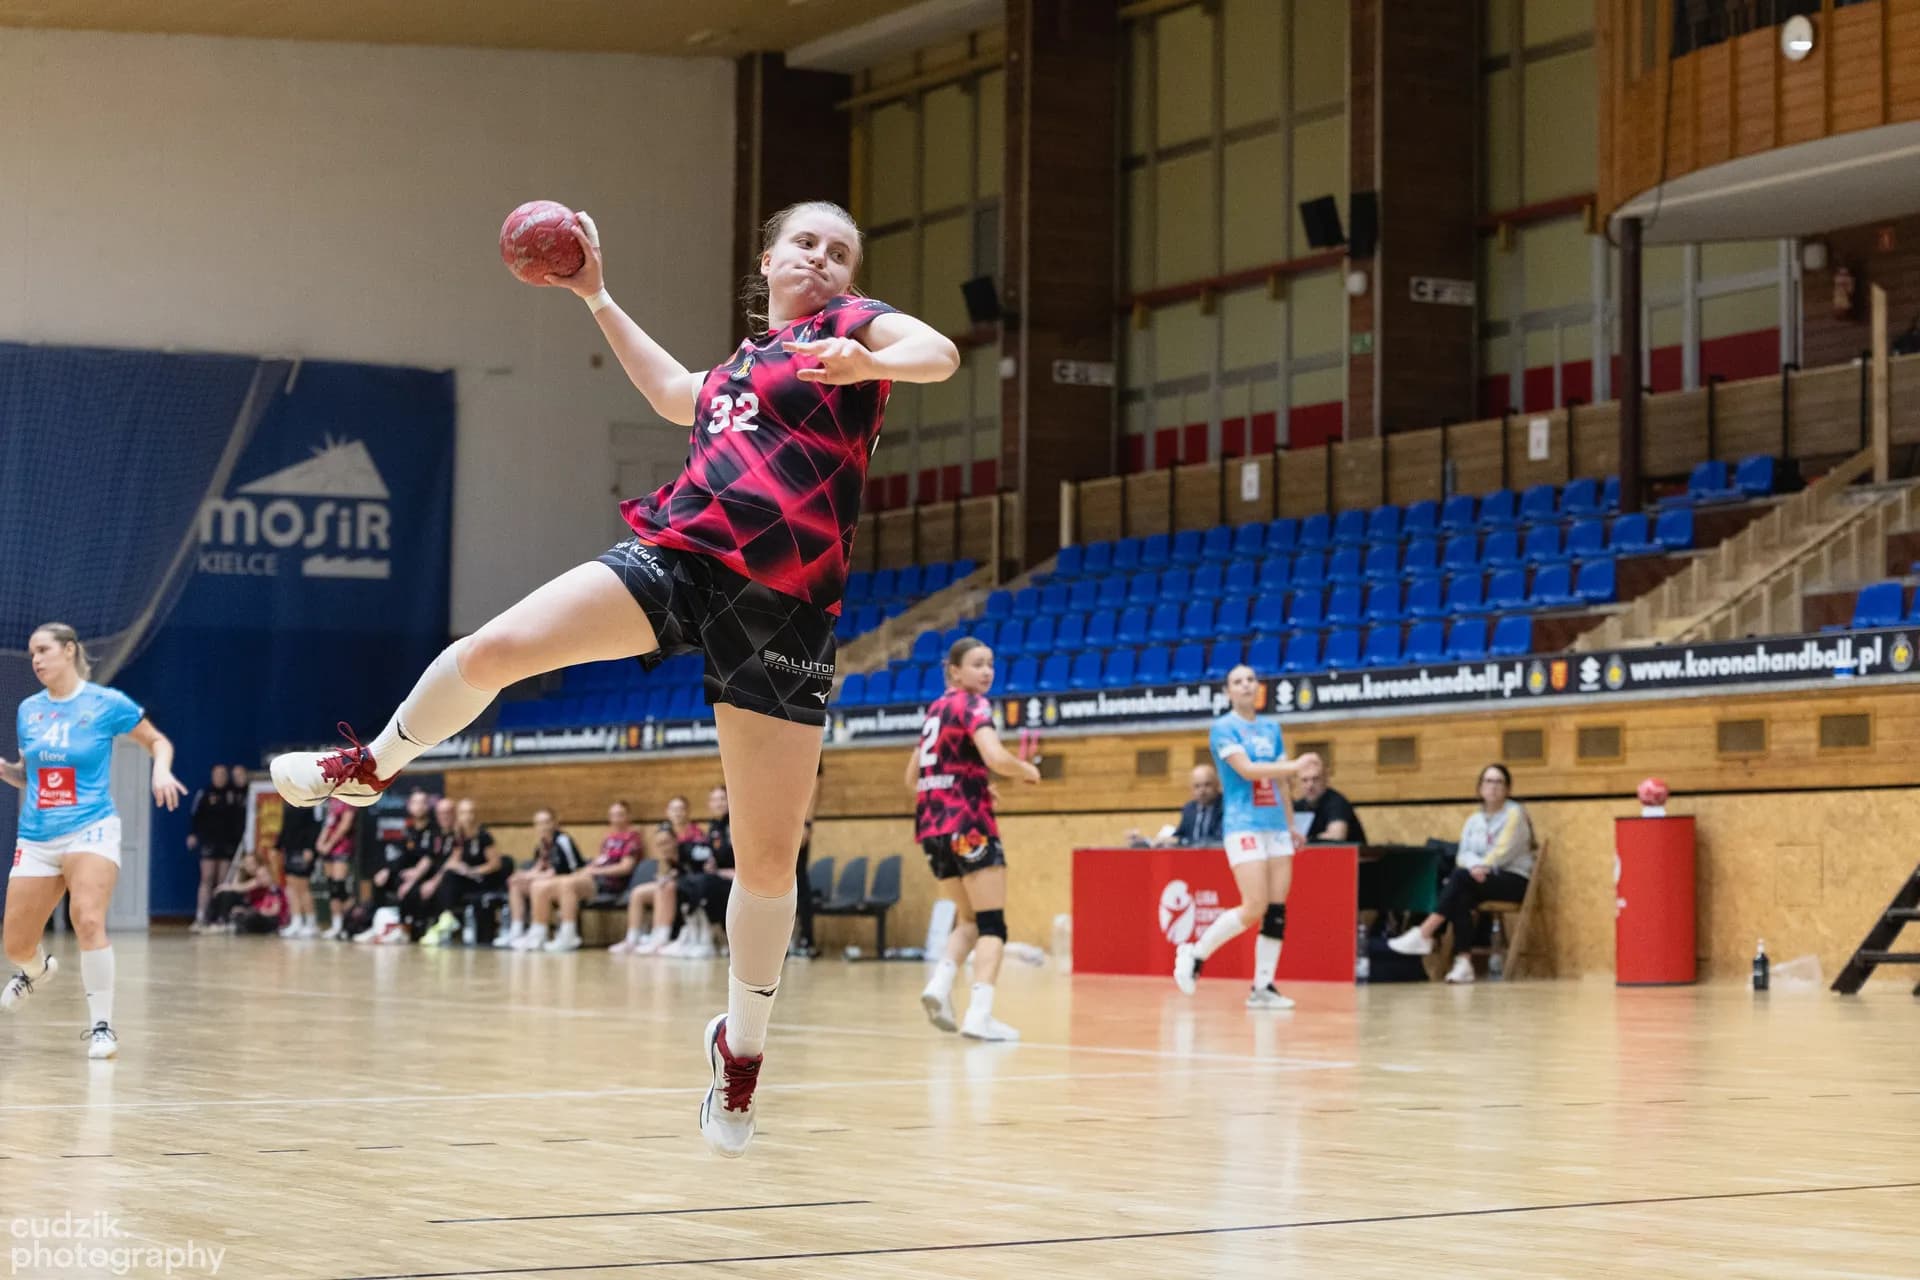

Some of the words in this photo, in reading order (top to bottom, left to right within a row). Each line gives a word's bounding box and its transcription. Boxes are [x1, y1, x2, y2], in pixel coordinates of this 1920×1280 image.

[707, 392, 760, 434] 32
[198, 551, 278, 576] KIELCE
[630, 543, 665, 577] Kielce
[1630, 636, 1883, 682] www.koronahandball.pl
[1317, 662, 1524, 704] www.koronahandball.pl
[1060, 686, 1230, 717] www.koronahandball.p
[40, 721, 72, 748] 41
